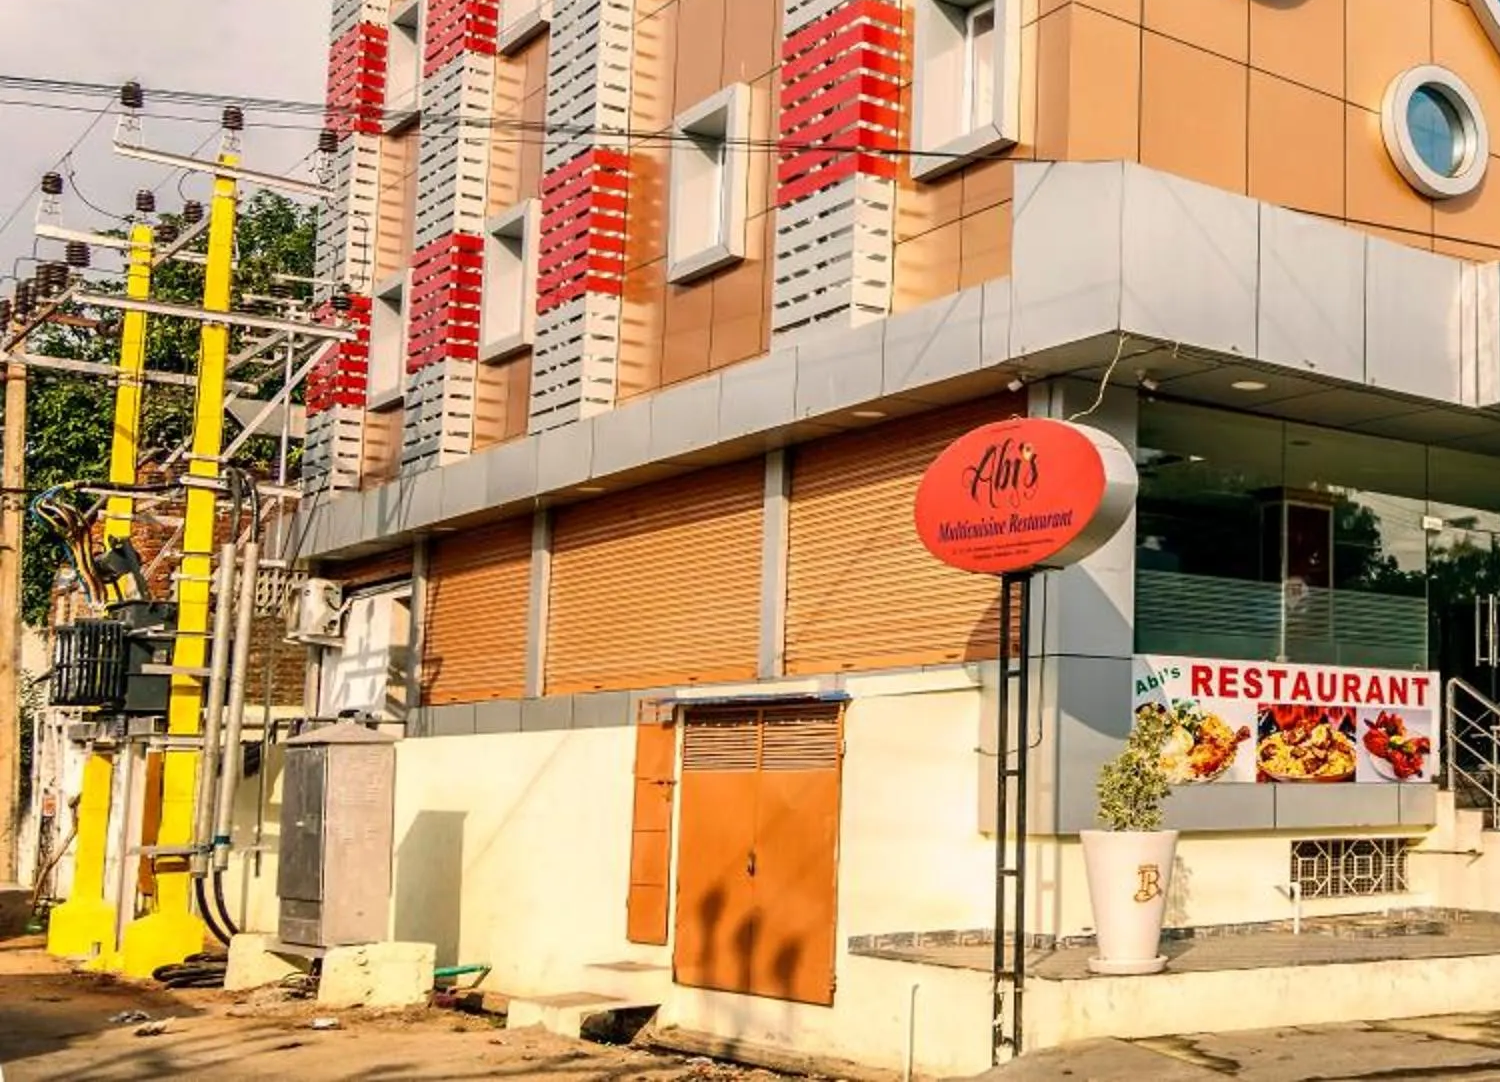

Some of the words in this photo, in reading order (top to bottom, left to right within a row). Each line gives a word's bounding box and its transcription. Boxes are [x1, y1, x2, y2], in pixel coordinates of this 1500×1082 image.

[962, 438, 1039, 508] Abi's
[1135, 667, 1181, 695] Abi's
[1191, 665, 1429, 706] RESTAURANT
